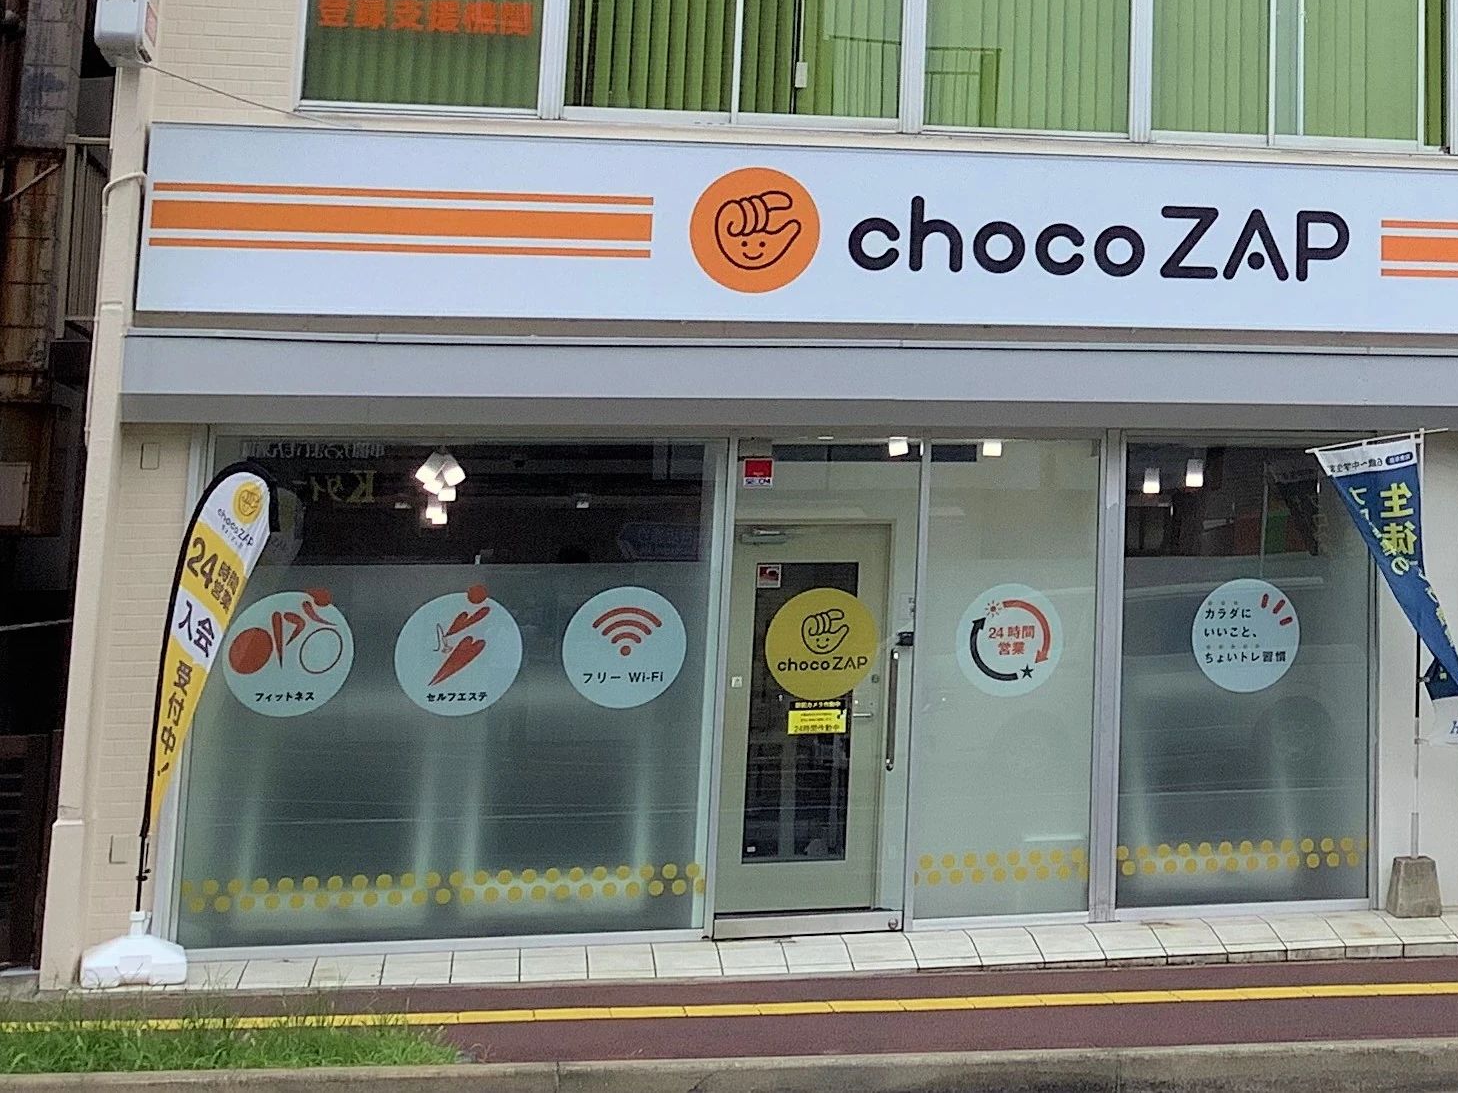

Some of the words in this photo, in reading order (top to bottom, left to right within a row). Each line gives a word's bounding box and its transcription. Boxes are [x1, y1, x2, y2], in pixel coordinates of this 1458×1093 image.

[847, 195, 1351, 283] chocoZAP
[1204, 608, 1252, 620] カラダに
[178, 599, 214, 657] 入会
[1204, 626, 1258, 639] いいこと、
[998, 642, 1026, 656] 営業
[777, 656, 868, 672] chocoZAP
[1204, 651, 1287, 664] ちょいトレ習慣
[583, 672, 622, 684] フリー
[629, 670, 665, 684] Wi-Fi
[254, 691, 315, 703] フィットネス
[426, 691, 488, 703] セルフエステ
